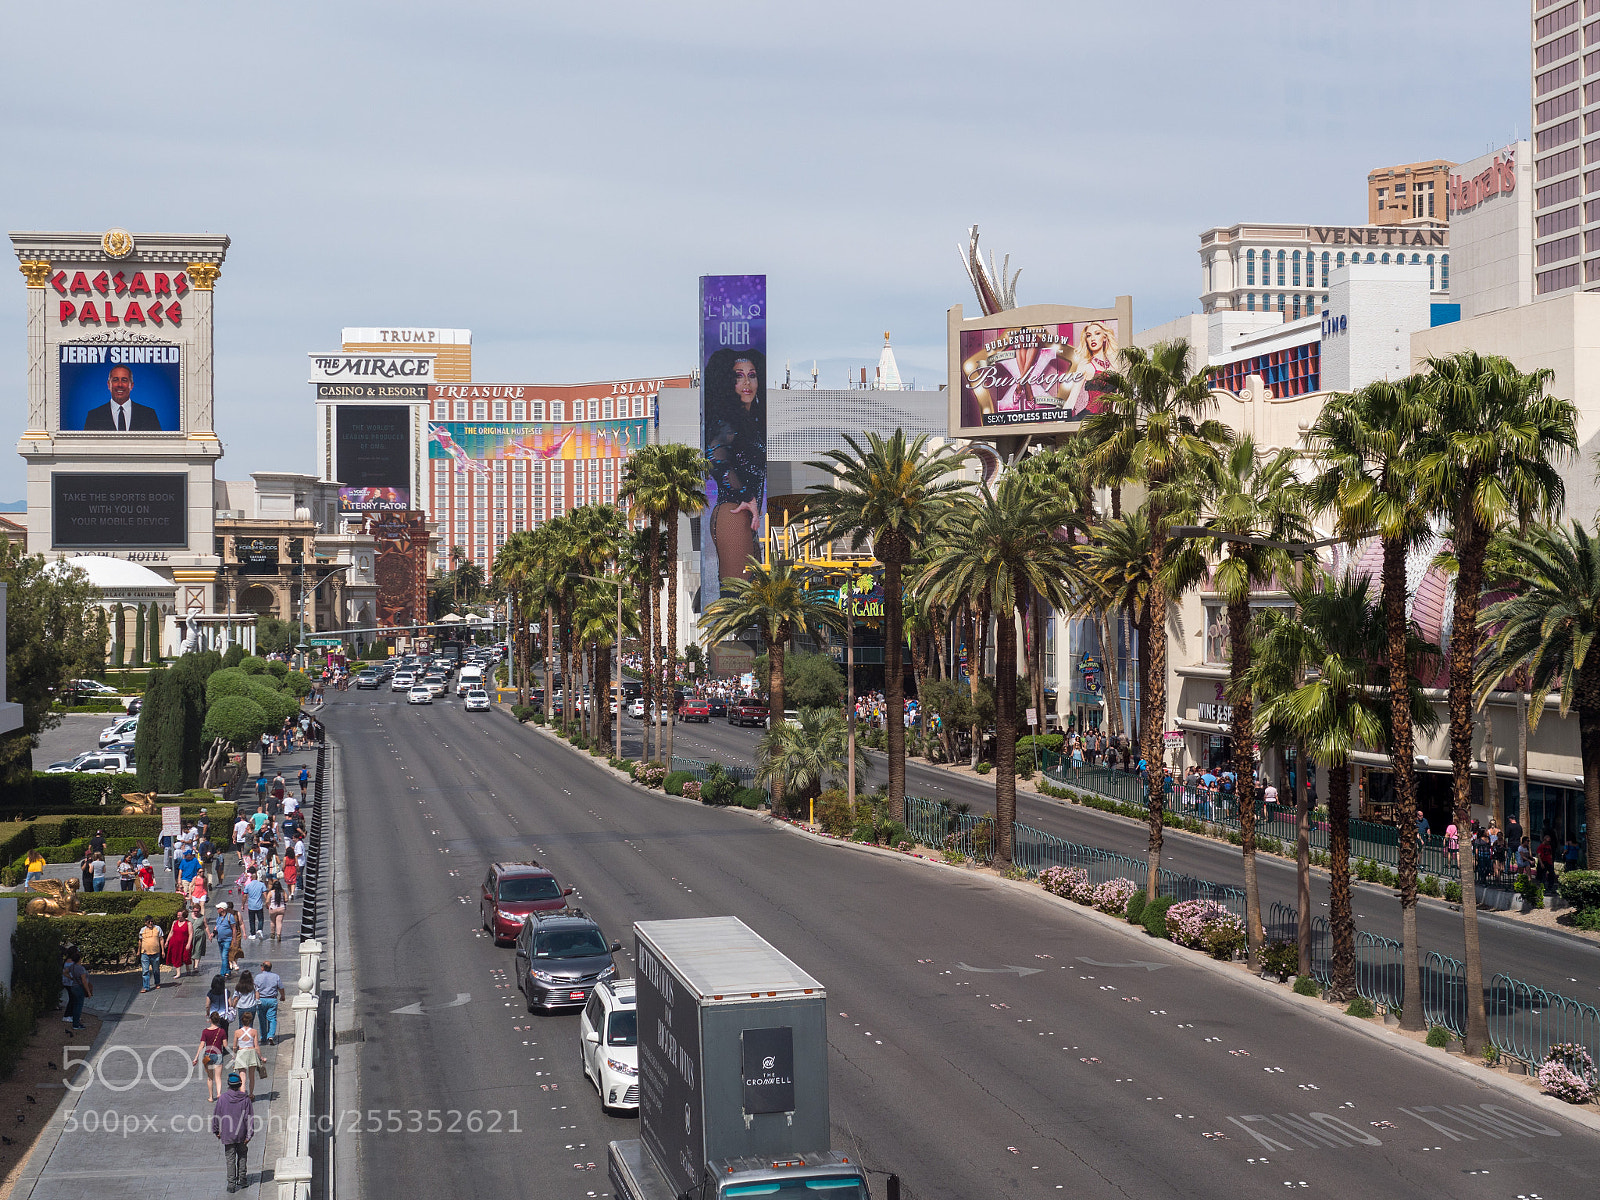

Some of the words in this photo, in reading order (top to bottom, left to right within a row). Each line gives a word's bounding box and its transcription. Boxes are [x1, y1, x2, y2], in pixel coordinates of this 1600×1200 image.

[1314, 227, 1445, 245] VENETIAN
[50, 270, 189, 295] CAESARS
[59, 300, 183, 323] PALACE
[708, 304, 761, 317] LINQ
[1321, 315, 1347, 336] LINQ
[380, 330, 436, 343] TRUMP
[720, 321, 750, 345] CHER
[985, 333, 1037, 352] BURLESQUE
[1041, 334, 1069, 345] SHOW
[61, 346, 107, 364] JERRY
[110, 347, 180, 364] SEINFELD
[315, 358, 340, 369] THE
[325, 358, 430, 378] MIRAGE
[966, 366, 1084, 392] Burlesque
[319, 386, 364, 396] CASINO
[366, 387, 376, 396] &
[378, 387, 426, 397] RESORT
[435, 385, 525, 399] TREASURE
[987, 414, 1006, 424] SEXY,
[1007, 412, 1040, 422] TOPLESS
[1042, 410, 1068, 420] REVUE
[464, 427, 477, 435] THE
[478, 427, 510, 435] ORIGINAL
[511, 427, 543, 435] MUST-SEE
[597, 425, 643, 447] MYST
[63, 493, 87, 502] TAKE
[89, 493, 108, 502] THE
[109, 493, 146, 502] SPORTS
[148, 493, 175, 502] BOOK
[88, 505, 112, 514] WITH
[113, 505, 134, 514] YOU
[135, 505, 149, 514] ON
[350, 502, 378, 510] TERRY
[380, 502, 407, 510] FATOR
[71, 517, 97, 526] YOUR
[99, 517, 134, 526] MOBILE
[136, 517, 170, 526] DEVICE
[126, 551, 168, 562] HOTEL
[1197, 702, 1216, 720] WINE
[746, 1077, 791, 1086] CROMWELL
